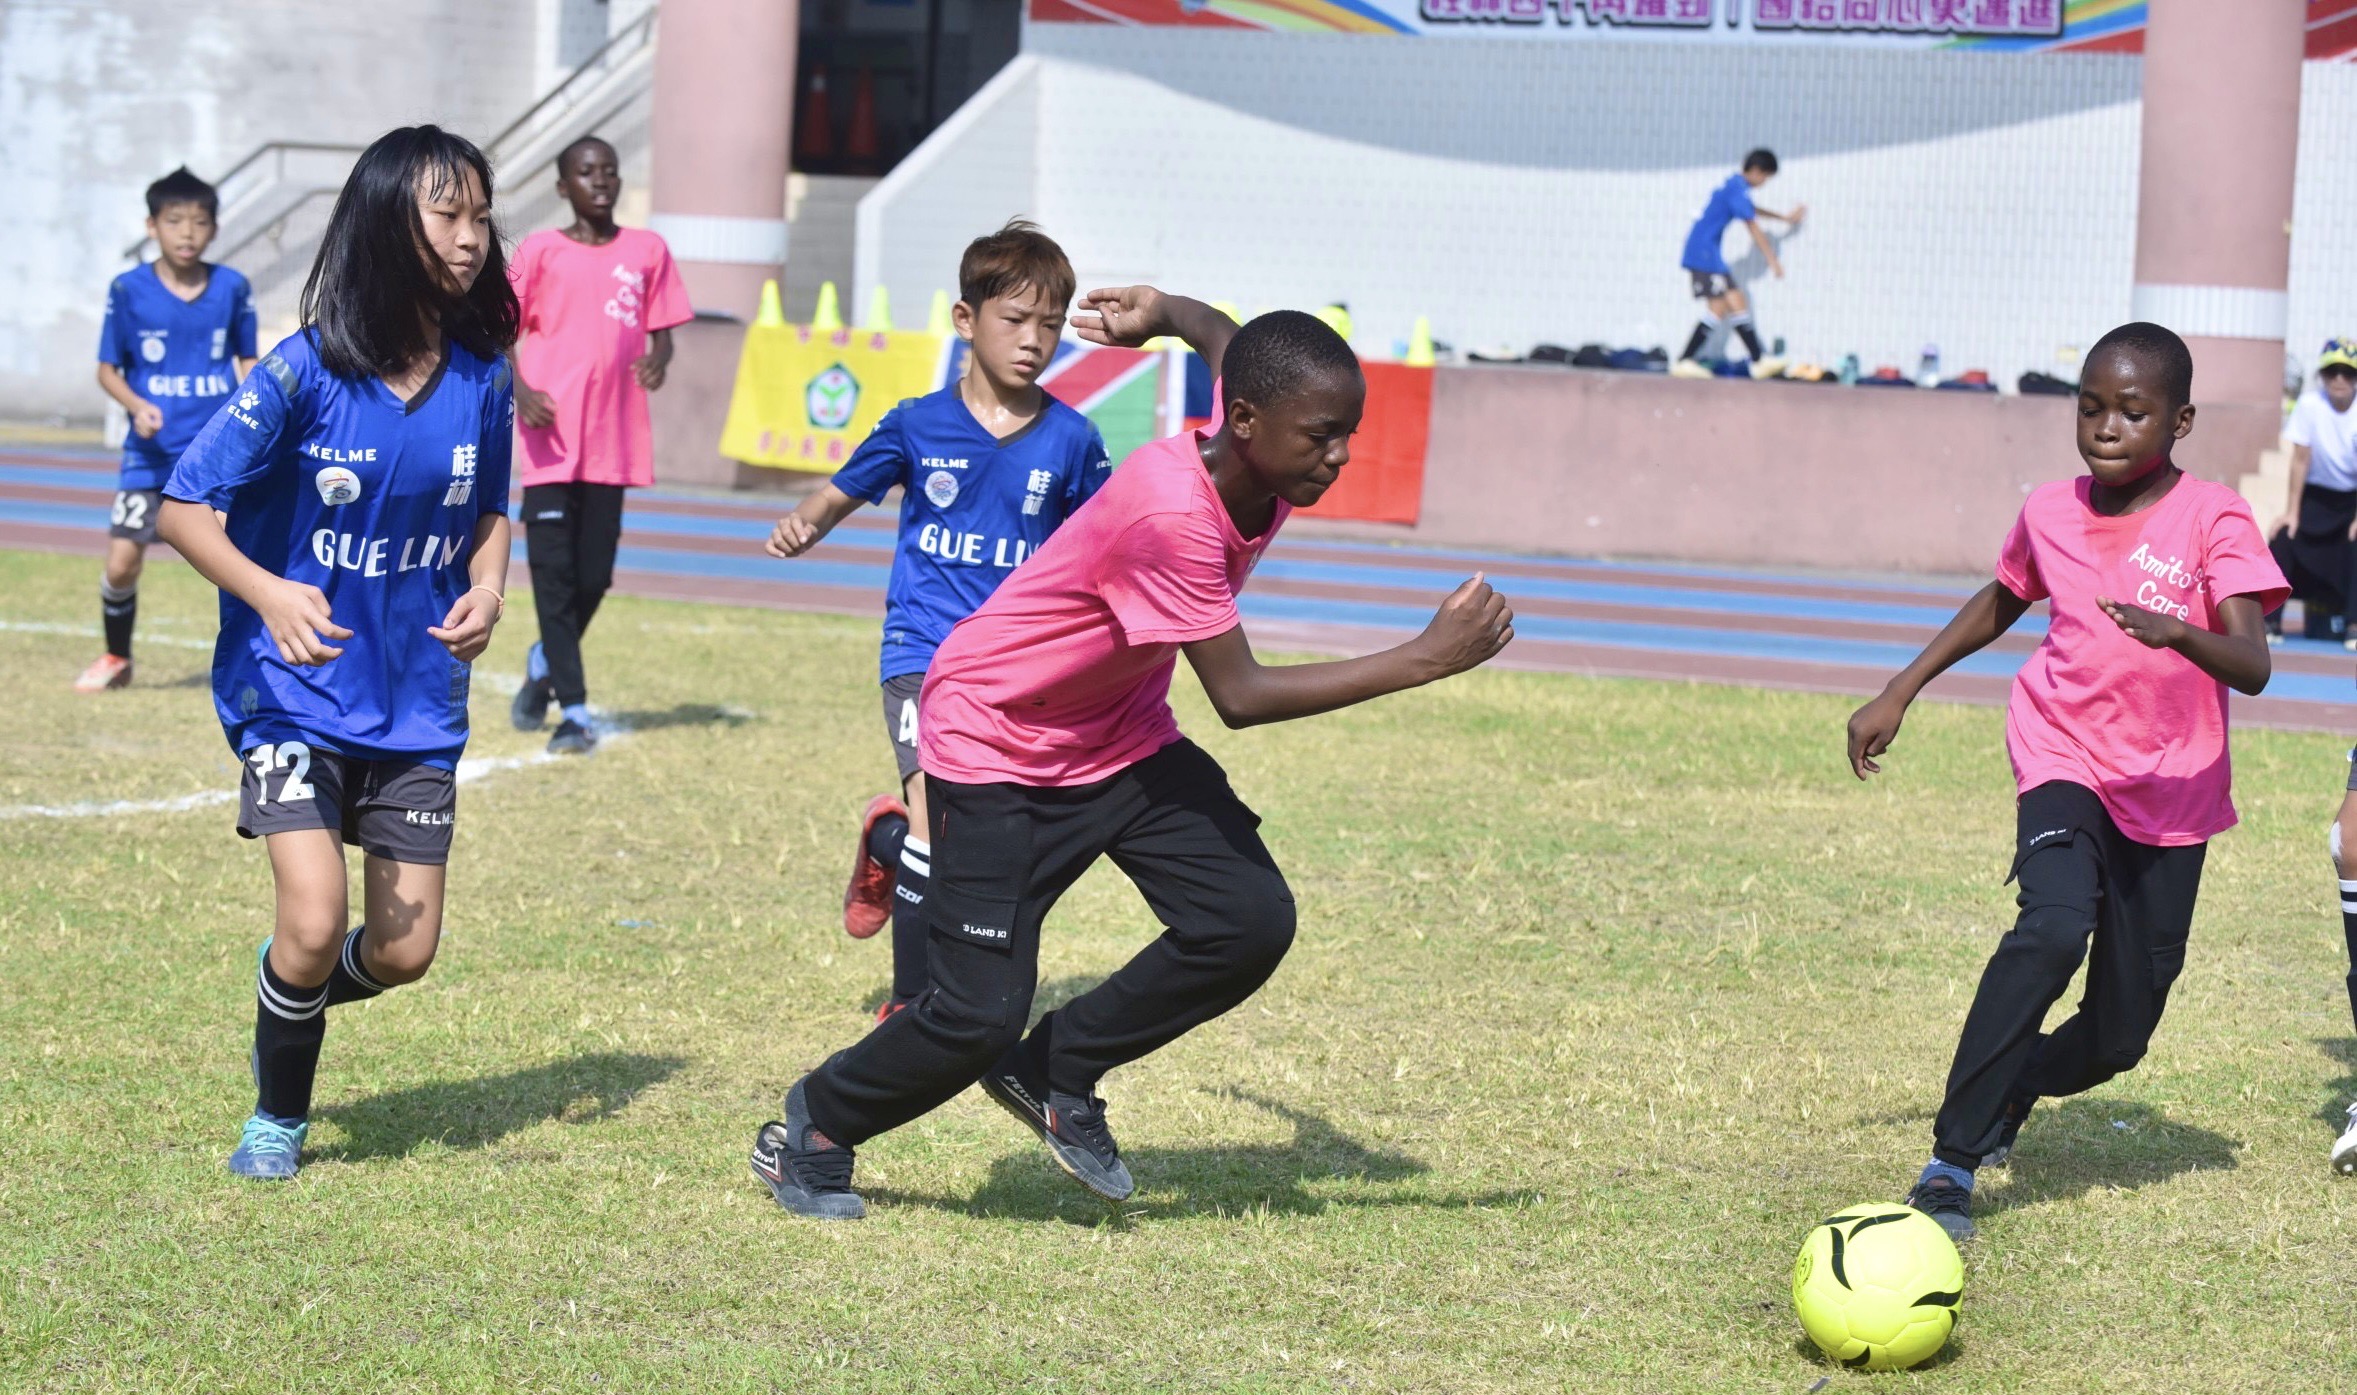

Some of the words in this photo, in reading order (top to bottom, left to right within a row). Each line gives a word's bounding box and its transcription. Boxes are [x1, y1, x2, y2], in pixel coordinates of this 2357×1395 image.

[148, 374, 191, 397] GUE
[227, 405, 260, 430] ELME
[309, 443, 377, 462] KELME
[921, 457, 969, 469] KELME
[443, 444, 477, 507] 桂林
[1021, 469, 1052, 516] 桂林
[312, 528, 389, 577] GUE
[398, 535, 465, 573] LIN
[919, 523, 985, 564] GUE
[2136, 580, 2189, 621] Care
[970, 926, 995, 937] LAND
